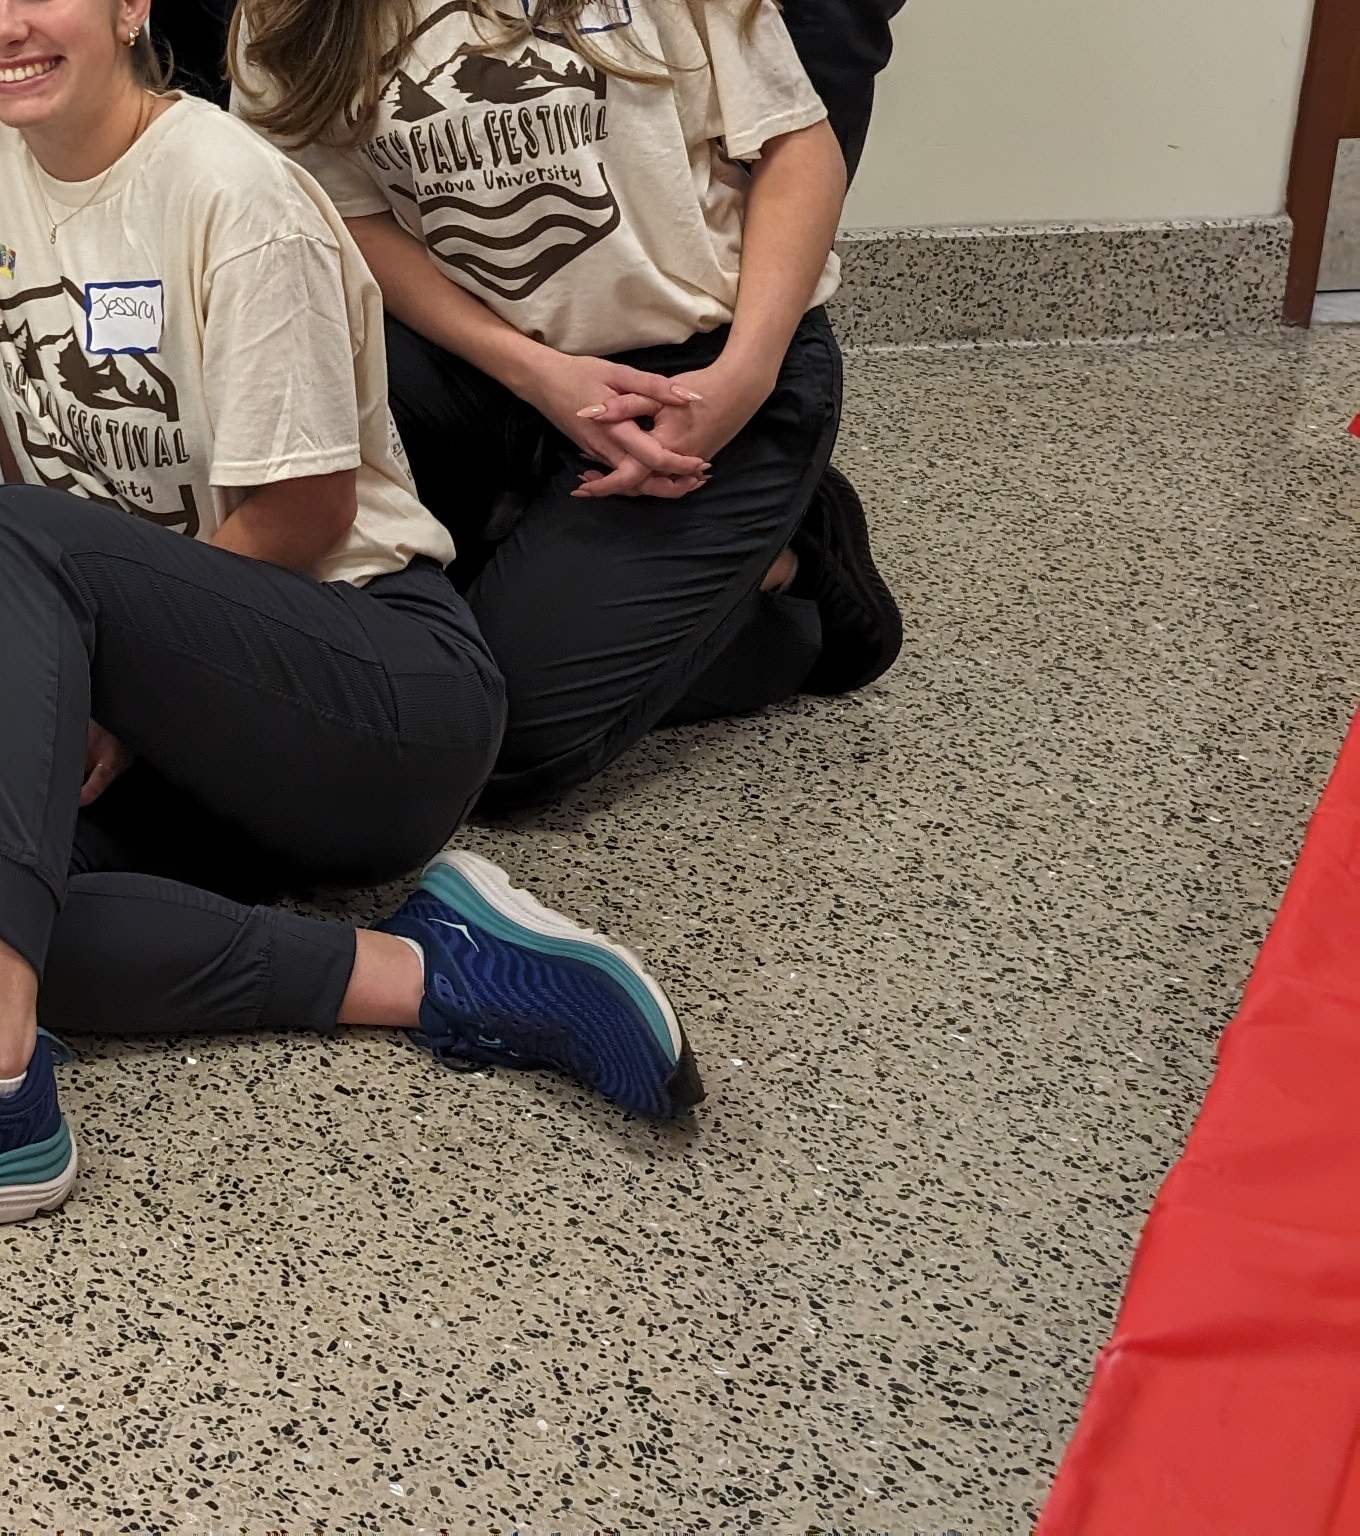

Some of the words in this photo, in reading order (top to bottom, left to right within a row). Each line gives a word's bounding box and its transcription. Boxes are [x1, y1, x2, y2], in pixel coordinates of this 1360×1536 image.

[409, 115, 484, 175] FALL
[483, 102, 609, 167] FESTIVAL
[415, 179, 476, 198] lanova
[482, 164, 583, 192] University
